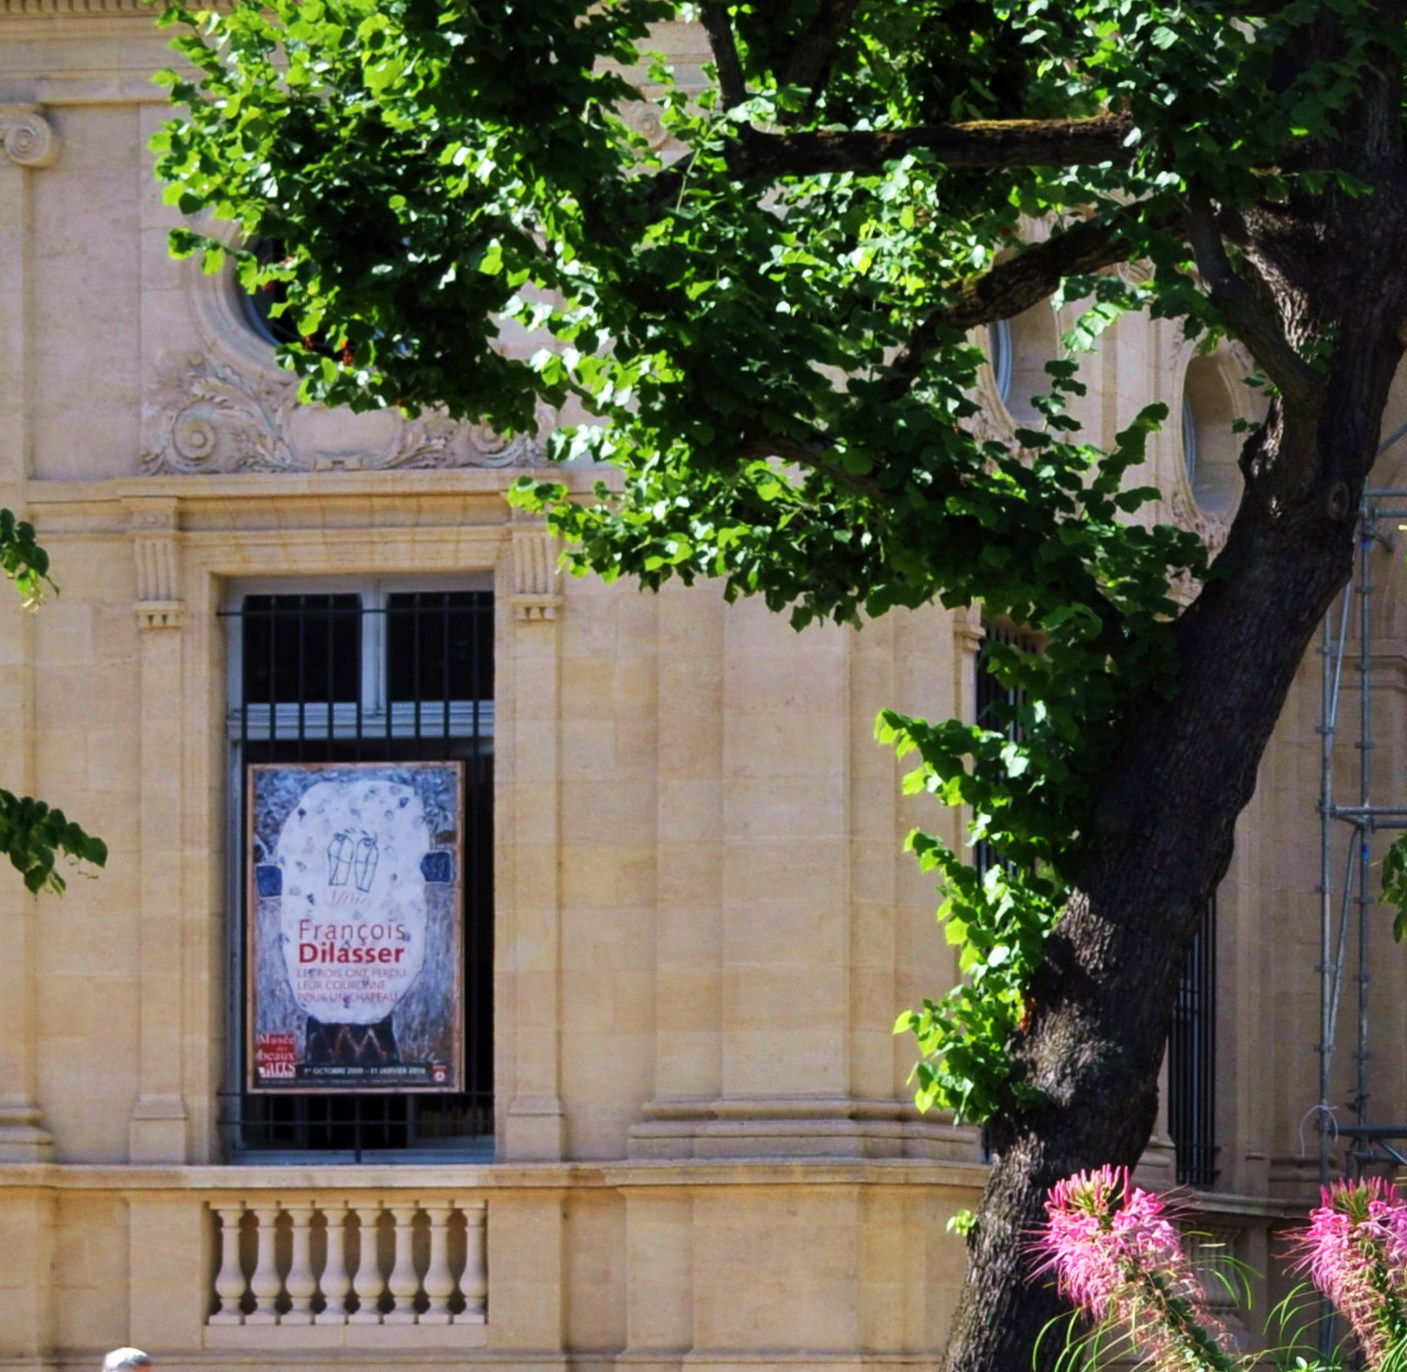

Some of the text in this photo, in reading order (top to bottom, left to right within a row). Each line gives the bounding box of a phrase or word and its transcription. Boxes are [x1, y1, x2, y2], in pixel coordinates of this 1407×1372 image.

[298, 919, 406, 945] François
[299, 942, 405, 963] Dilasser
[345, 968, 368, 978] ONT
[297, 980, 385, 990] LEUR COURONNE
[297, 992, 327, 1002] POUR
[348, 992, 398, 1002] CHAPEAU
